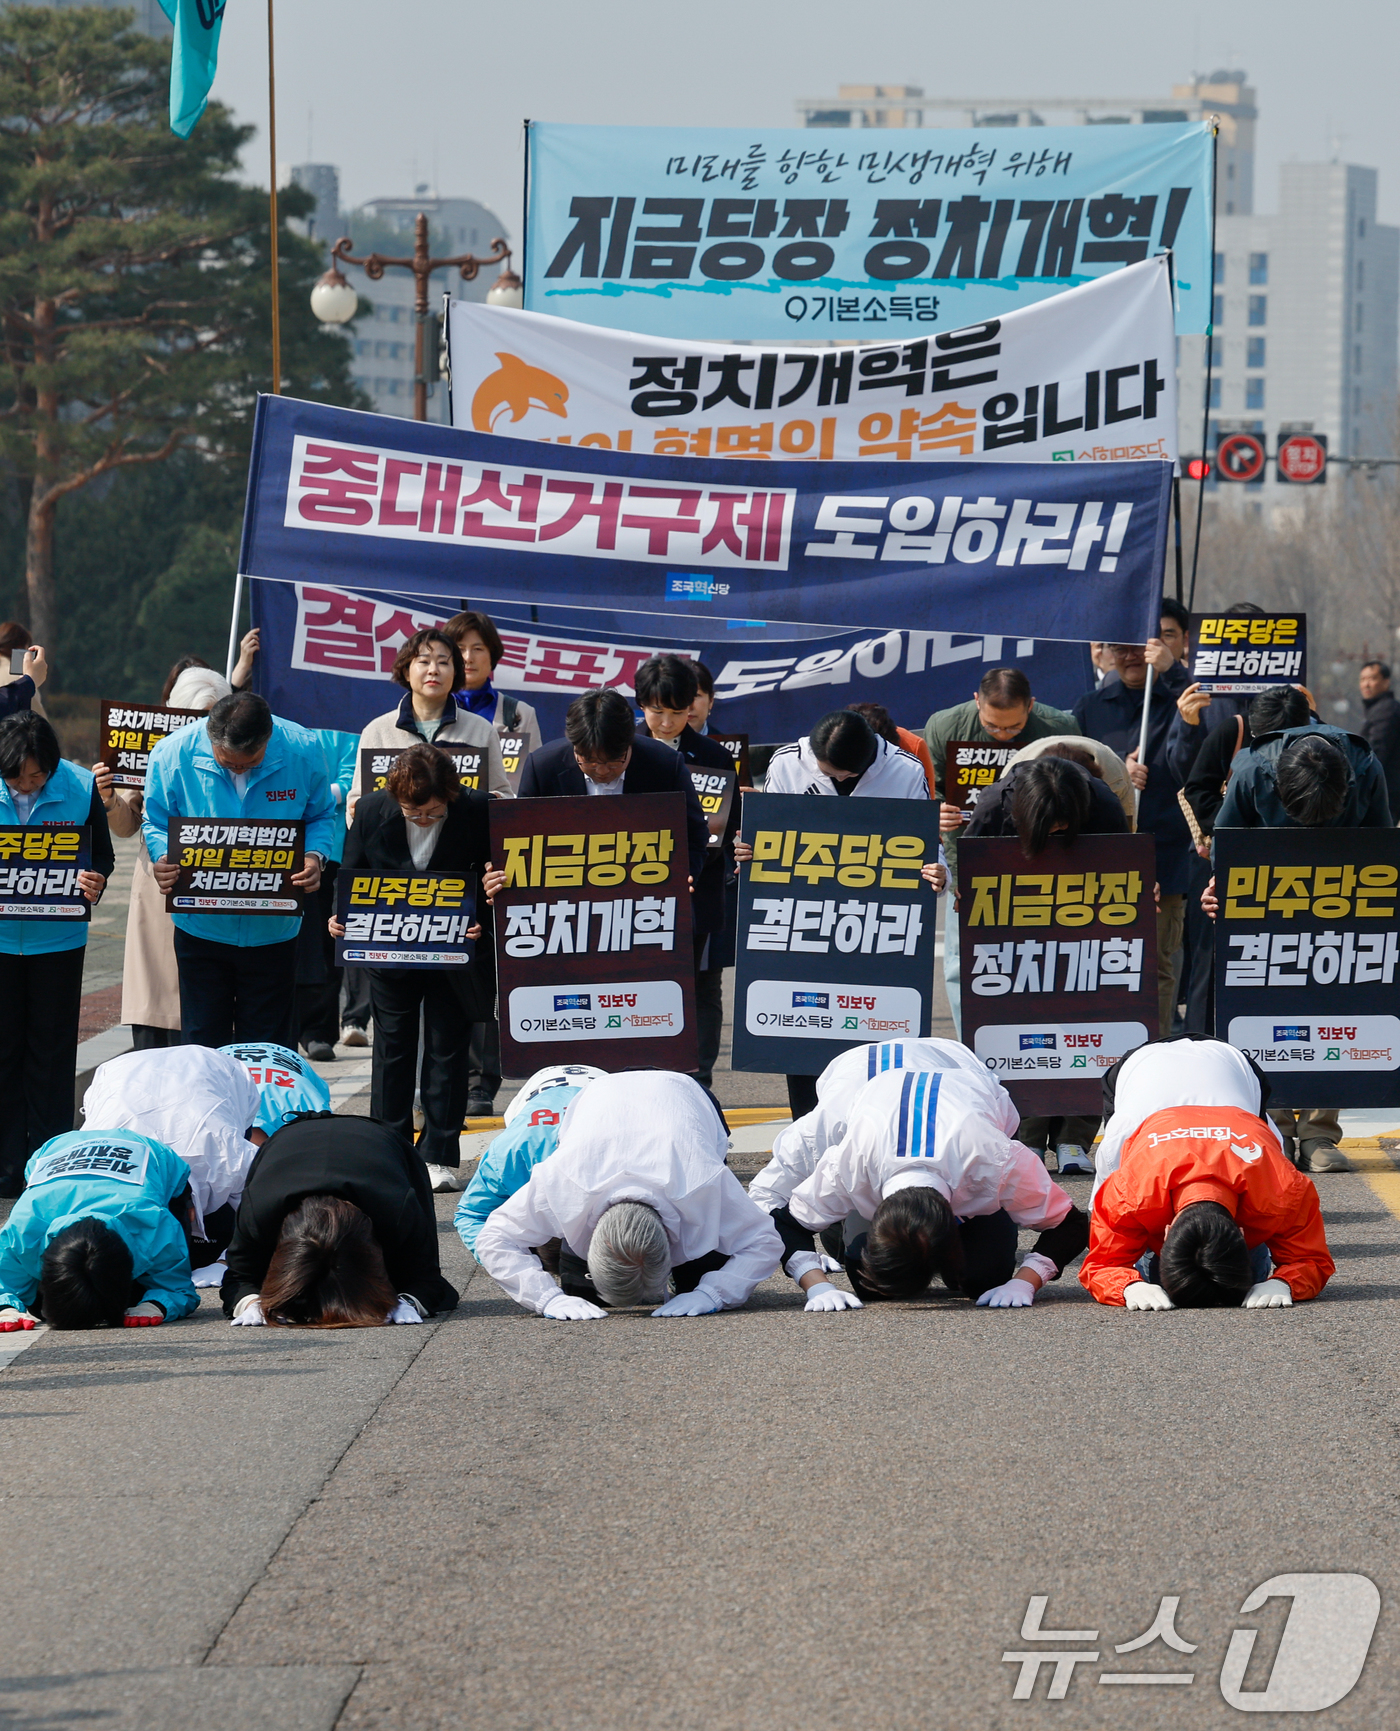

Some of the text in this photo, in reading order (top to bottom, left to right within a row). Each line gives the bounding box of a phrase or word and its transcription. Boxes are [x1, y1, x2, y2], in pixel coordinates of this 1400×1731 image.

[665, 142, 1073, 191] 미래를 향한 민생개혁 위해
[544, 187, 1192, 281] 지금당장 정치개혁!
[811, 296, 940, 323] 기본소득당
[629, 319, 1002, 418] 정치개혁은
[858, 358, 1165, 461] 약속입니다
[298, 443, 1134, 573] 중대선거구제 도입하라!
[671, 580, 730, 595] 조국혁신당
[1199, 619, 1299, 644] 민주당은
[1193, 651, 1303, 676] 결단하라!
[108, 729, 143, 750] 31일
[957, 768, 996, 785] 31일
[266, 789, 297, 802] 진보당
[179, 825, 297, 847] 정치개혁법안
[180, 847, 295, 869] 31일 본회의
[502, 829, 675, 888] 지금당장
[749, 830, 926, 889] 민주당은
[190, 870, 282, 892] 처리하라
[350, 877, 466, 907] 민주당은
[1224, 865, 1399, 919] 민주당은
[968, 870, 1142, 928] 지금당장
[343, 913, 470, 944] 결단하라!
[505, 896, 677, 958] 정치개혁
[746, 898, 924, 956] 결단하라
[971, 937, 1144, 996] 정치개혁
[1225, 931, 1400, 987] 결단하라
[598, 993, 637, 1008] 진보당
[837, 995, 876, 1010] 진보당
[534, 1013, 674, 1032] 기본소득당 사회민주당
[769, 1014, 910, 1033] 기본소득당 사회민주당
[1317, 1027, 1357, 1040] 진보당
[1063, 1034, 1103, 1048] 진보당
[999, 1056, 1062, 1070] 기본소득당
[1253, 1048, 1392, 1062] 기본소득당 사회민주당
[1148, 1126, 1248, 1148] 사회민주당
